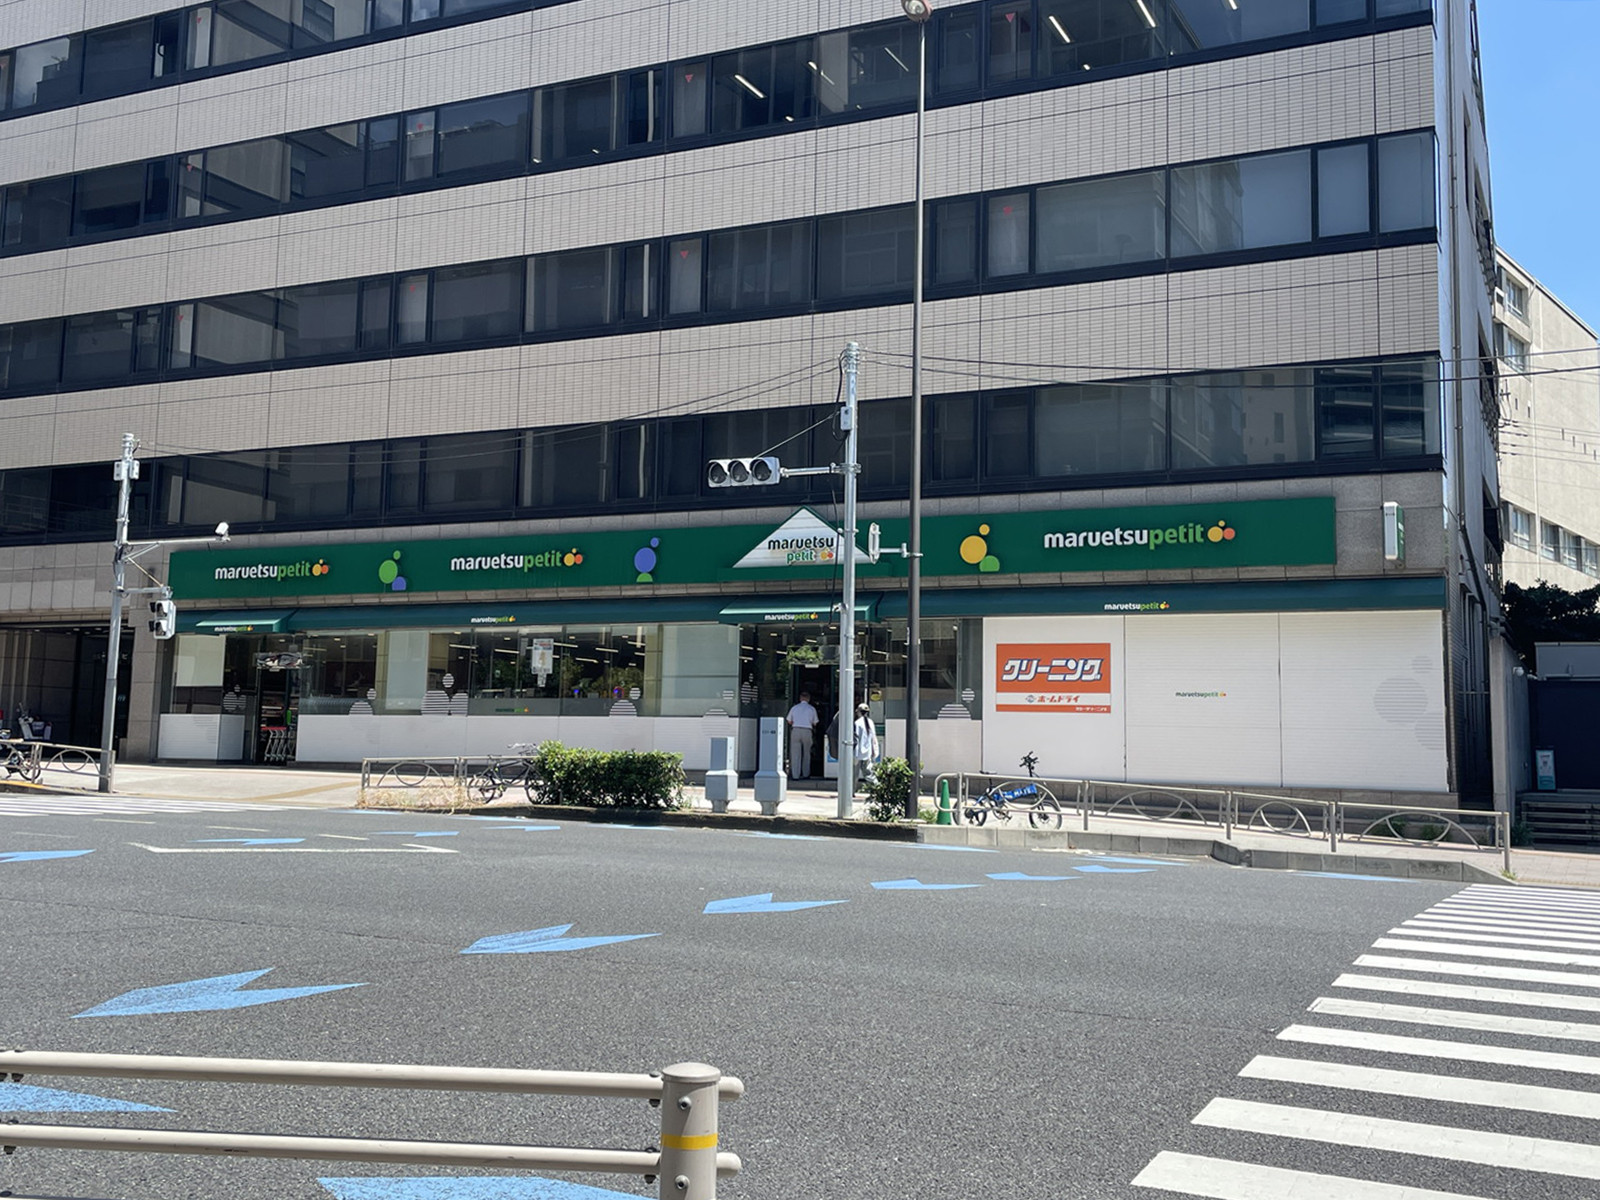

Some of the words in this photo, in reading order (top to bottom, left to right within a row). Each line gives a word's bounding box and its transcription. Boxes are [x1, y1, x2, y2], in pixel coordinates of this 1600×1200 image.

[768, 536, 834, 549] maruetsu
[1044, 523, 1204, 550] maruetsupetit
[451, 550, 562, 573] maruetsupetit
[786, 551, 814, 564] petit
[215, 561, 311, 581] maruetsupetit
[1104, 602, 1159, 611] maruetsupetit
[1001, 658, 1104, 682] クリーニング
